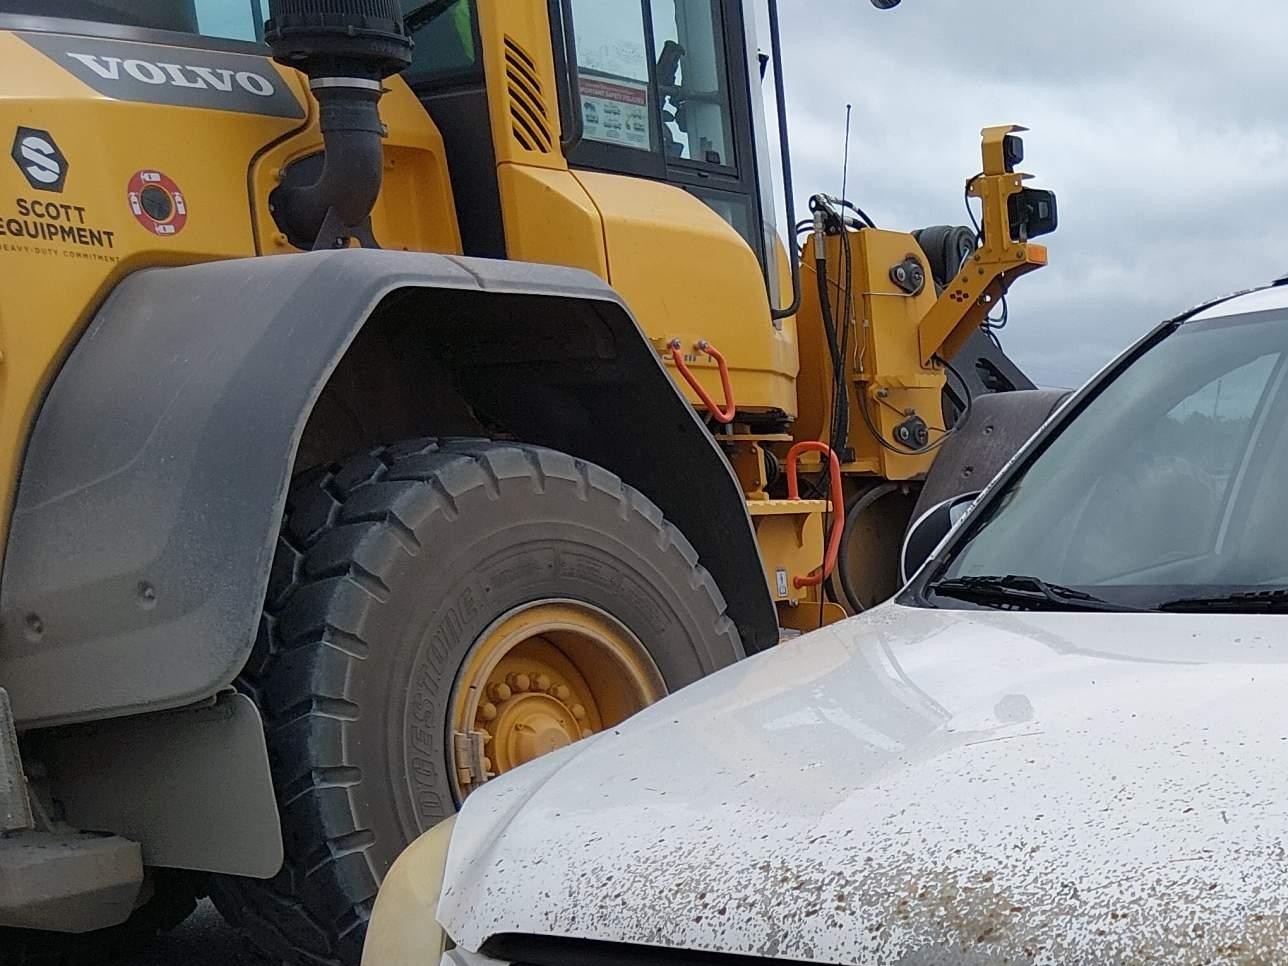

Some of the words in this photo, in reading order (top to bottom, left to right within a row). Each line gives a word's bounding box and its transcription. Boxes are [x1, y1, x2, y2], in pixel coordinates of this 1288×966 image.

[66, 52, 275, 96] VOLVO
[16, 198, 85, 224] SCOTT
[0, 243, 58, 256] EAVY-DUTY
